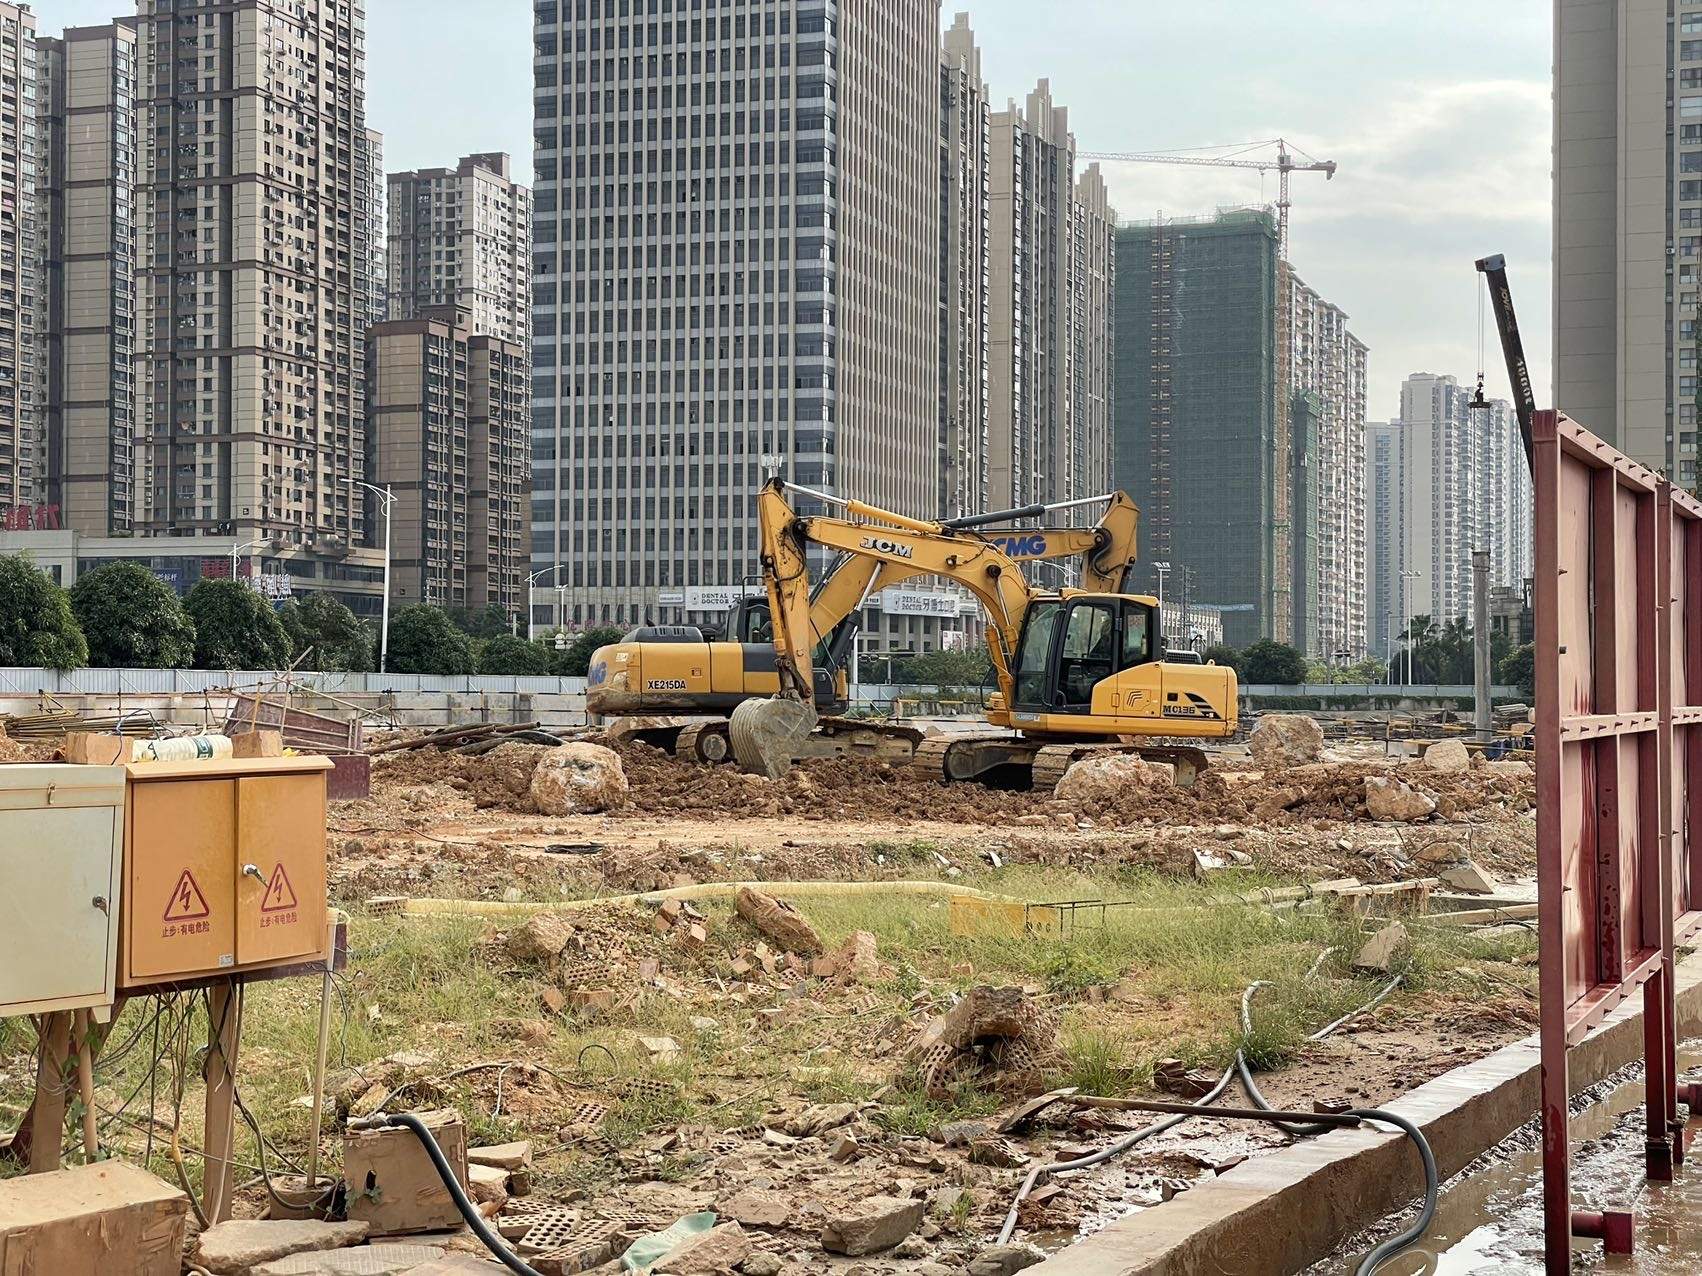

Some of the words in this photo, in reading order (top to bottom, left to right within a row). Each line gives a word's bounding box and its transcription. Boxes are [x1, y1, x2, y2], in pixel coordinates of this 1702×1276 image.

[861, 537, 913, 559] JCM
[992, 536, 1046, 556] CMG
[647, 680, 687, 690] XE215DA
